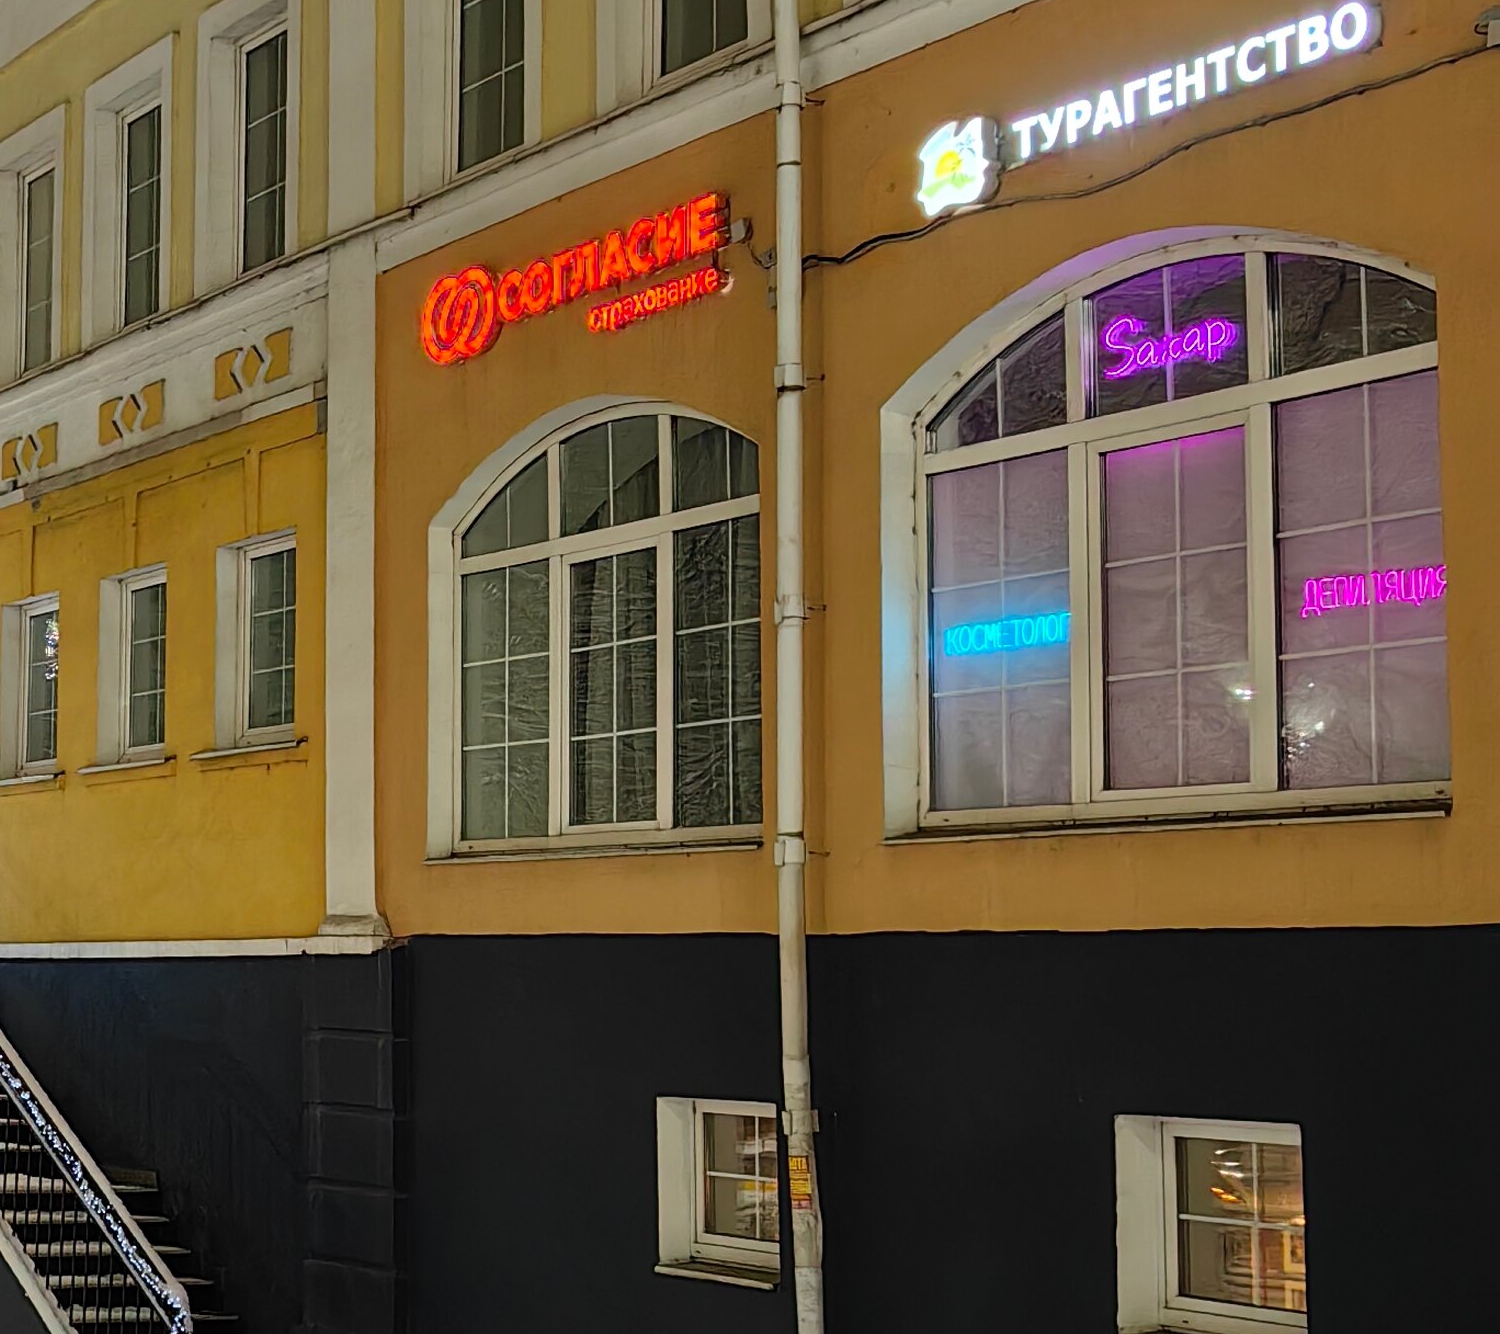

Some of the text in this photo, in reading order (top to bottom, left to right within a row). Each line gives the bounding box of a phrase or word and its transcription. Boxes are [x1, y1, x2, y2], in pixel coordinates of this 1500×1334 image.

[1011, 1, 1368, 159] ТУРАГЕНТСТВО
[499, 192, 719, 323] СОГЛАСИЕ
[587, 267, 719, 332] страхование
